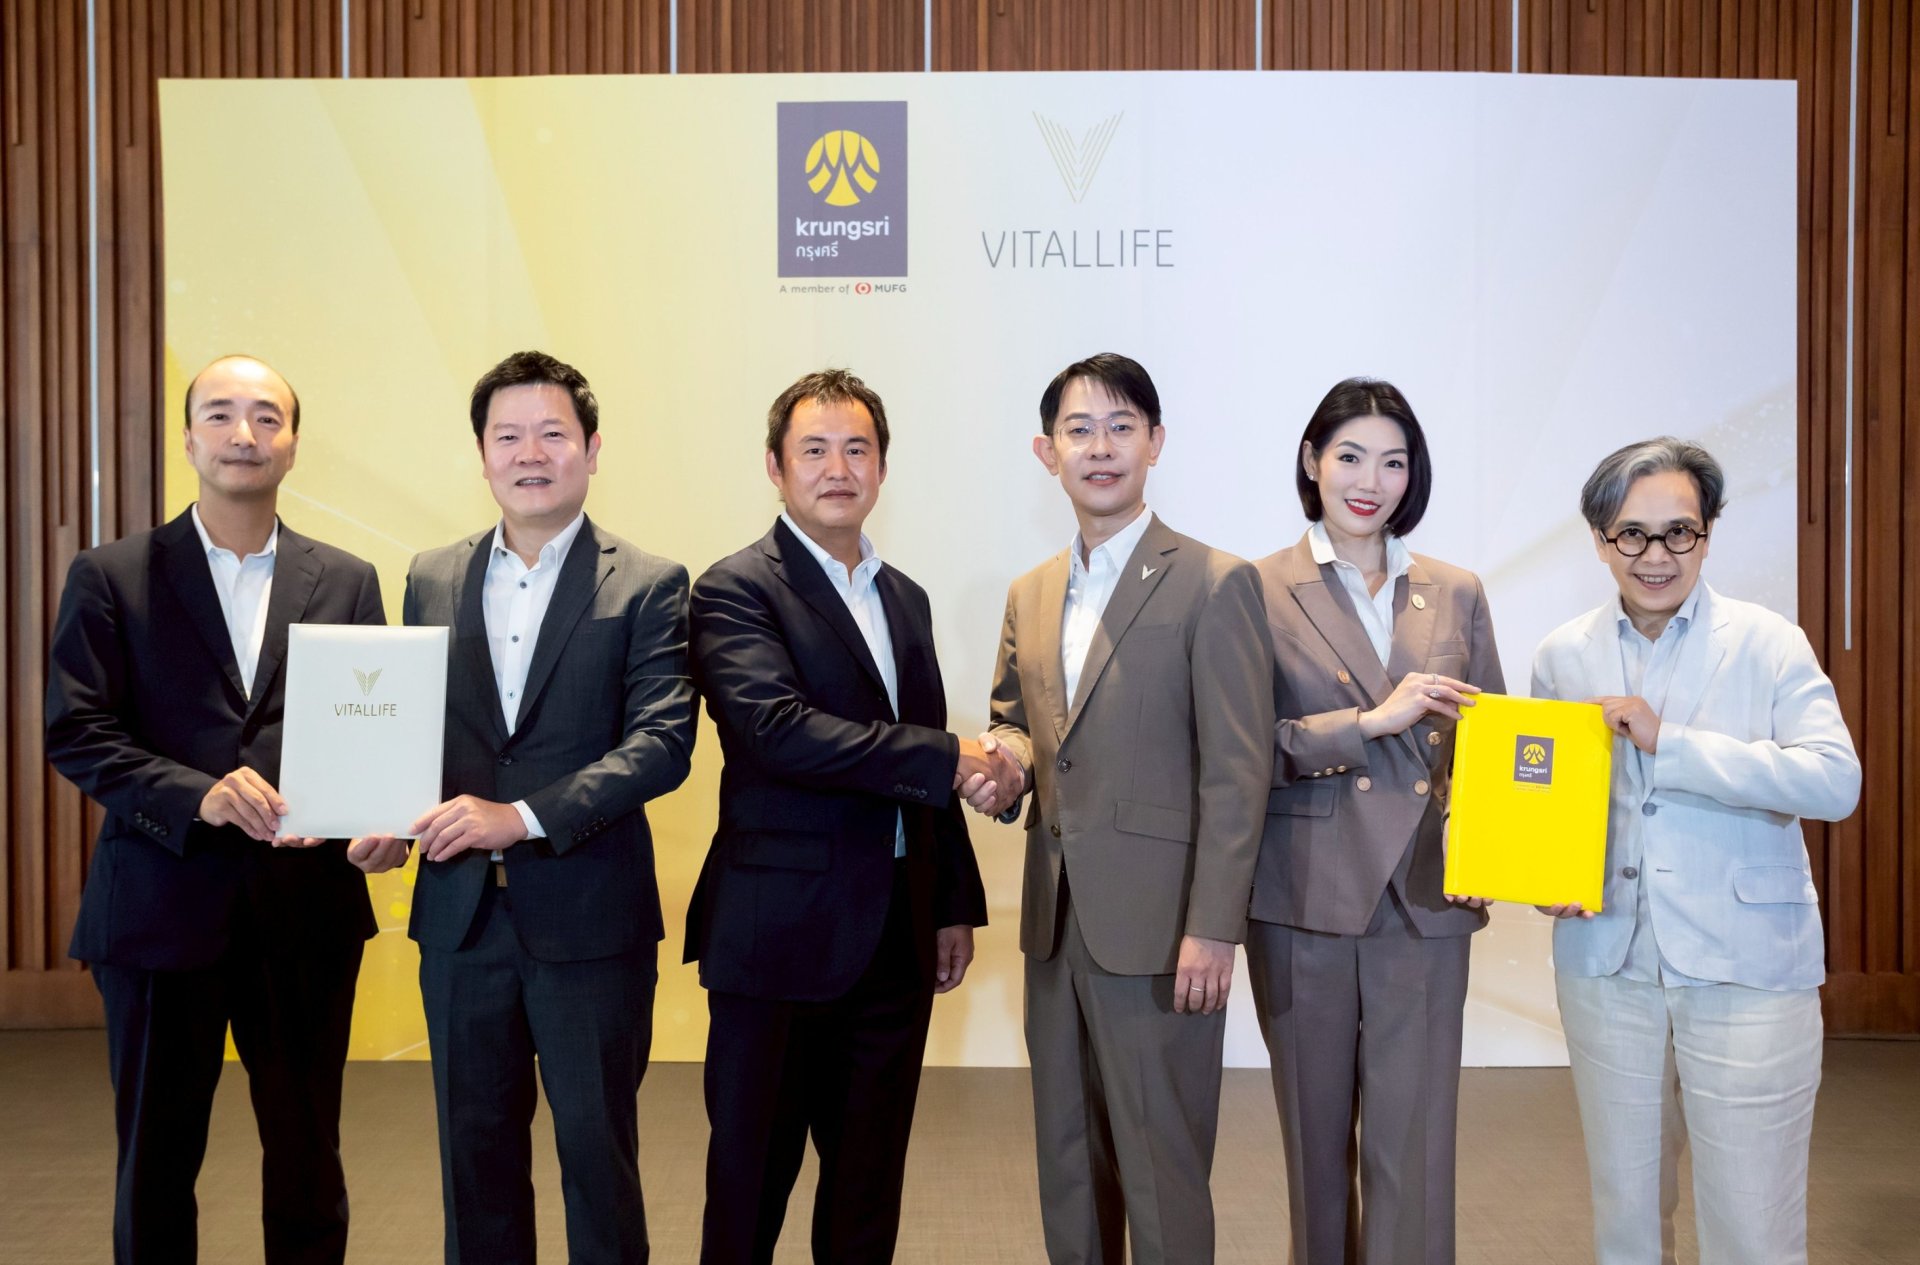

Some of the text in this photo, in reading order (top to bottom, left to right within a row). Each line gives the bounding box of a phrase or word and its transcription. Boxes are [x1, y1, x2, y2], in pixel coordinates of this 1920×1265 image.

[795, 216, 890, 241] krungsri
[795, 240, 840, 262] กรุงศรี
[981, 229, 1175, 268] VITALLIFE
[779, 284, 907, 295] A member of MUFG
[334, 703, 397, 717] VITALLIFE
[1519, 765, 1548, 774] krungsri
